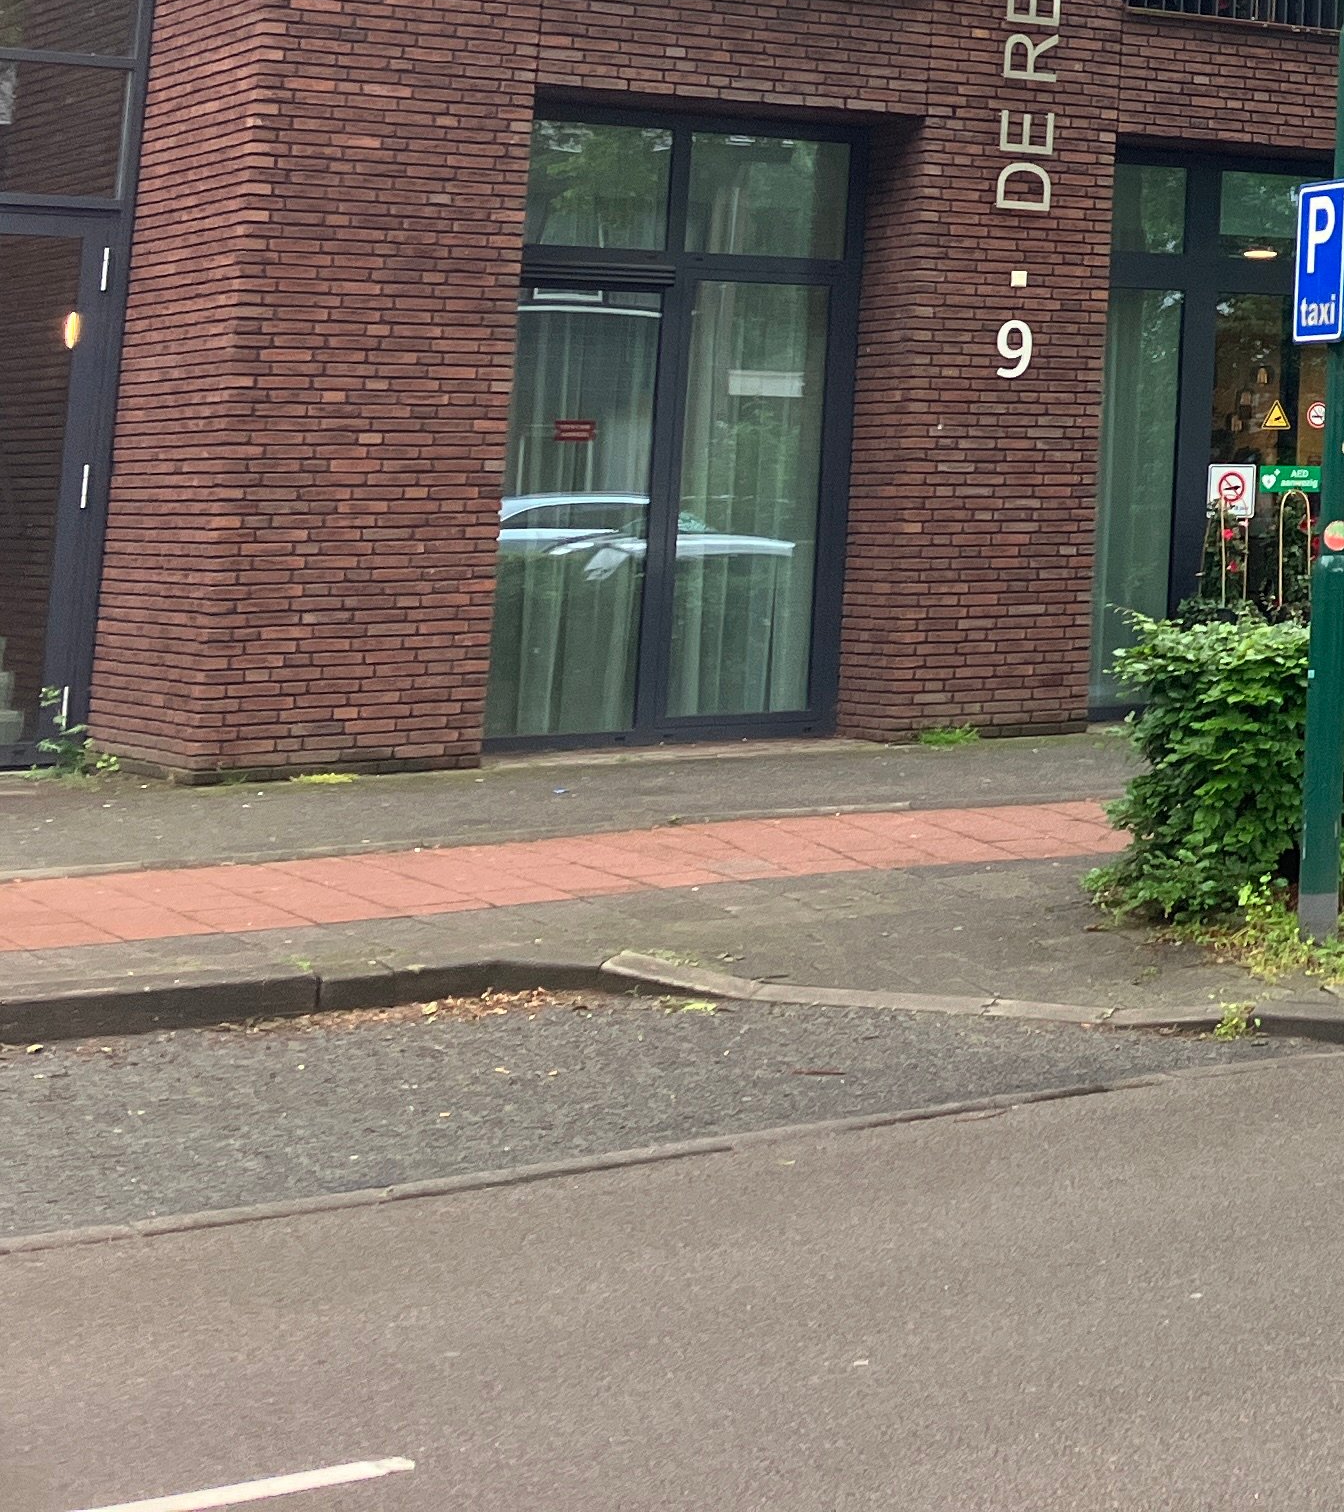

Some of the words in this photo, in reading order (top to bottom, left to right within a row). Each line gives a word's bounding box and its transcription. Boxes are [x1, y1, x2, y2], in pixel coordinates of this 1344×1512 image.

[996, 109, 1056, 211] DE
[1306, 196, 1336, 274] P
[1300, 293, 1337, 327] taxi
[996, 319, 1033, 379] 9
